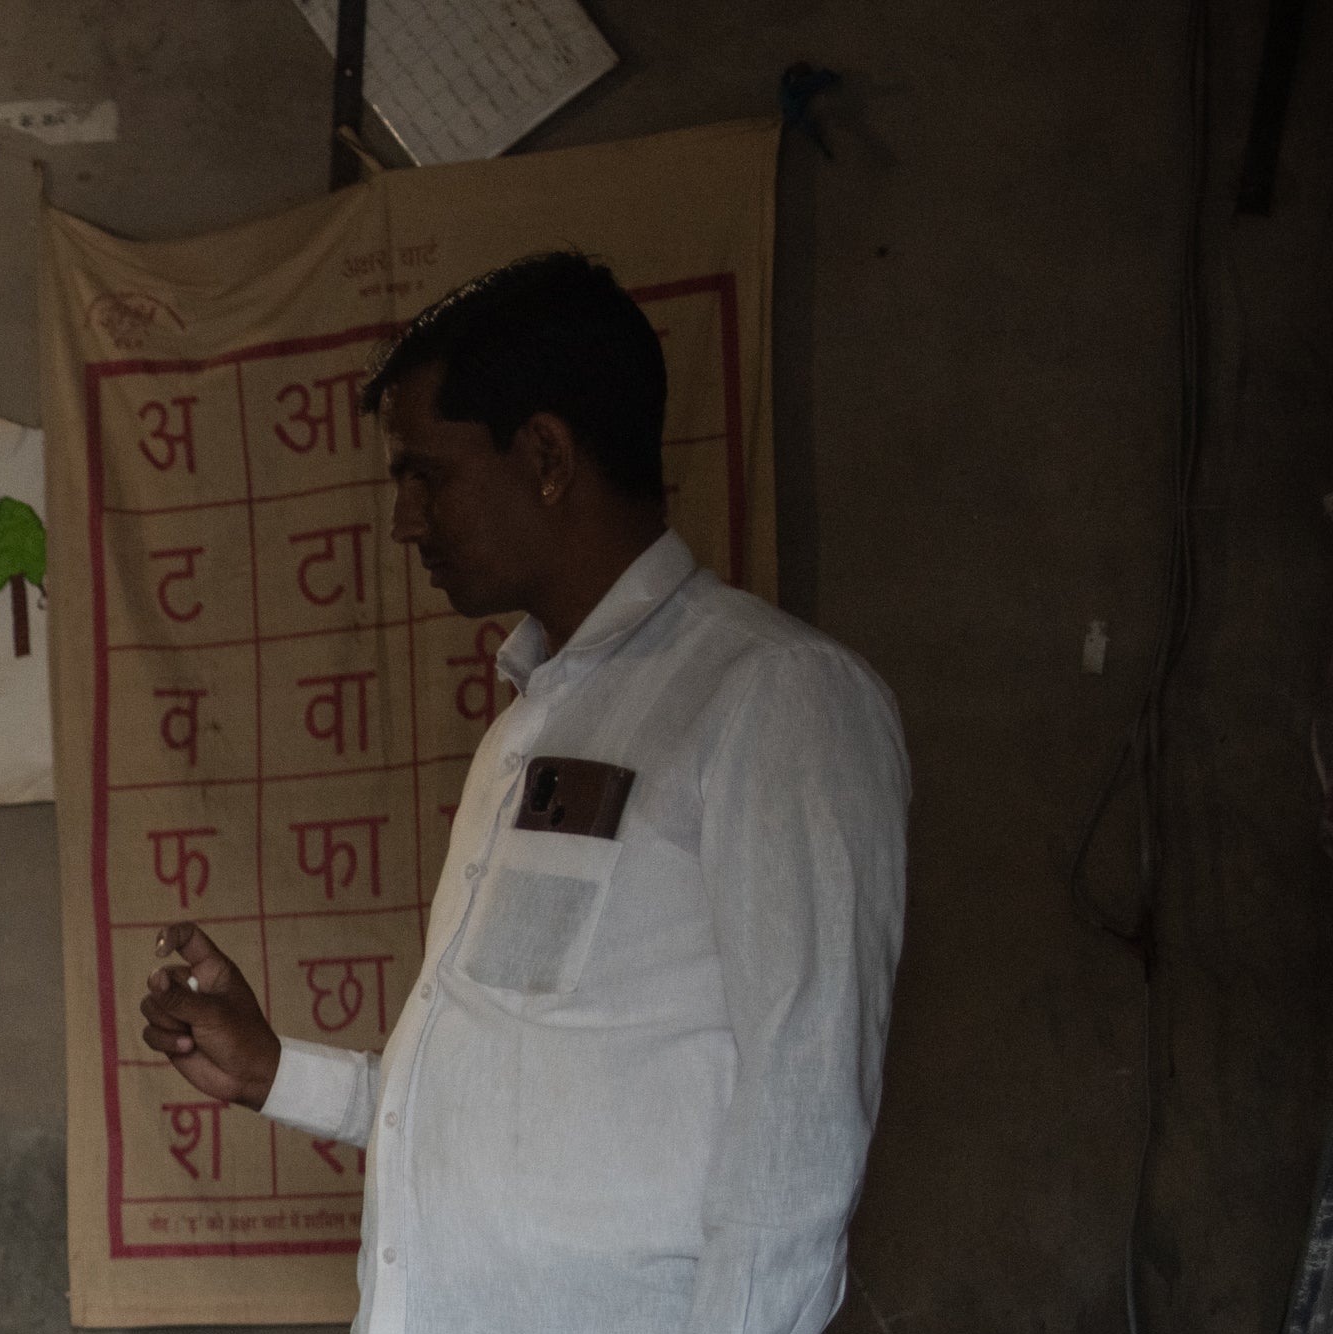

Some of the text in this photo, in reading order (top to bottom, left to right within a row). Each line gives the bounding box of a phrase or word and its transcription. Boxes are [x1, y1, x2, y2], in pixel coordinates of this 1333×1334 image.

[136, 367, 367, 474] अ आ
[149, 521, 372, 624] ट टा
[154, 684, 209, 768] व
[297, 668, 376, 762] वा
[147, 825, 219, 907] फ
[290, 814, 389, 900] फा
[297, 955, 394, 1034] छा
[161, 1098, 230, 1182] श
